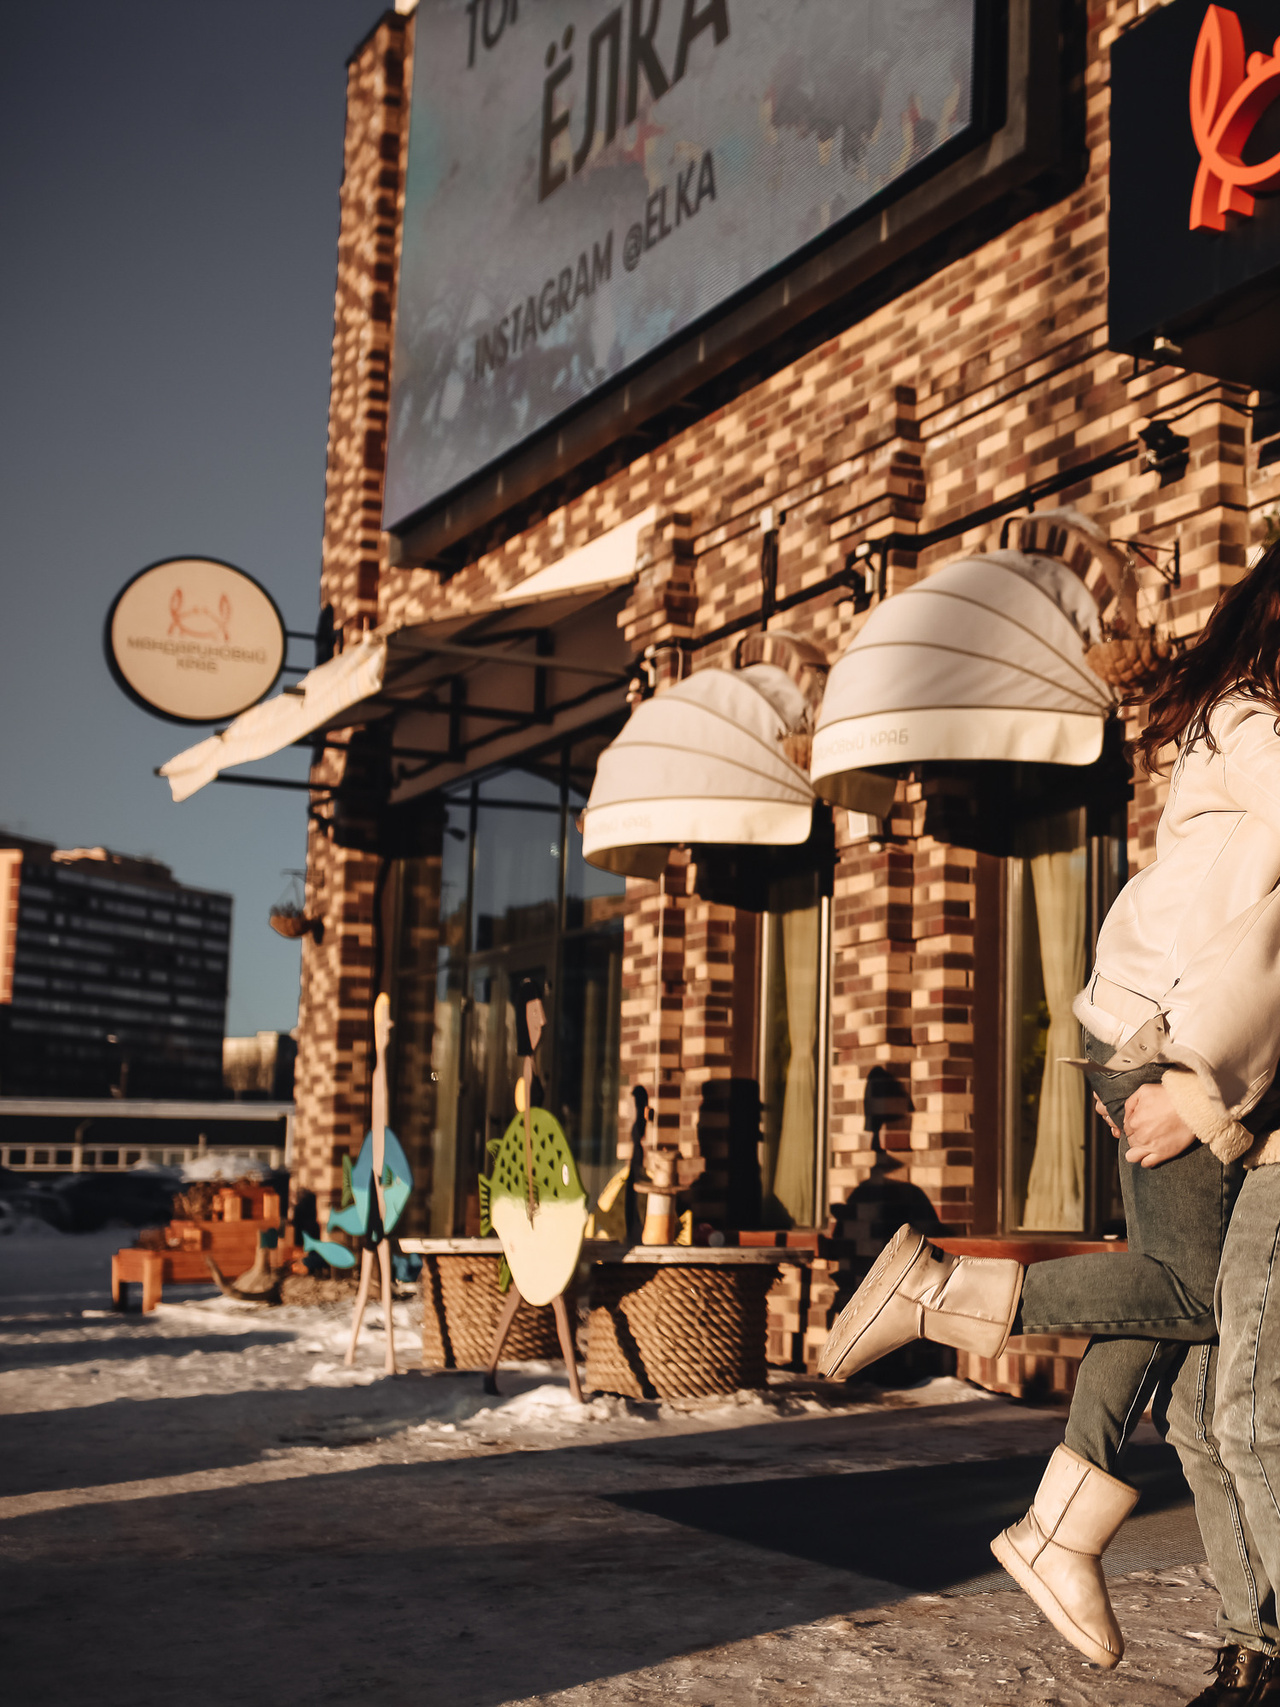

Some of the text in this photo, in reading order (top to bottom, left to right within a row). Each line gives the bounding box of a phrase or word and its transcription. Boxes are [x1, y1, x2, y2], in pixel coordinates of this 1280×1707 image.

[538, 0, 730, 204] ЁЛКА
[474, 150, 717, 382] INSTAGRAM @ELKA
[870, 728, 909, 748] КРАБ
